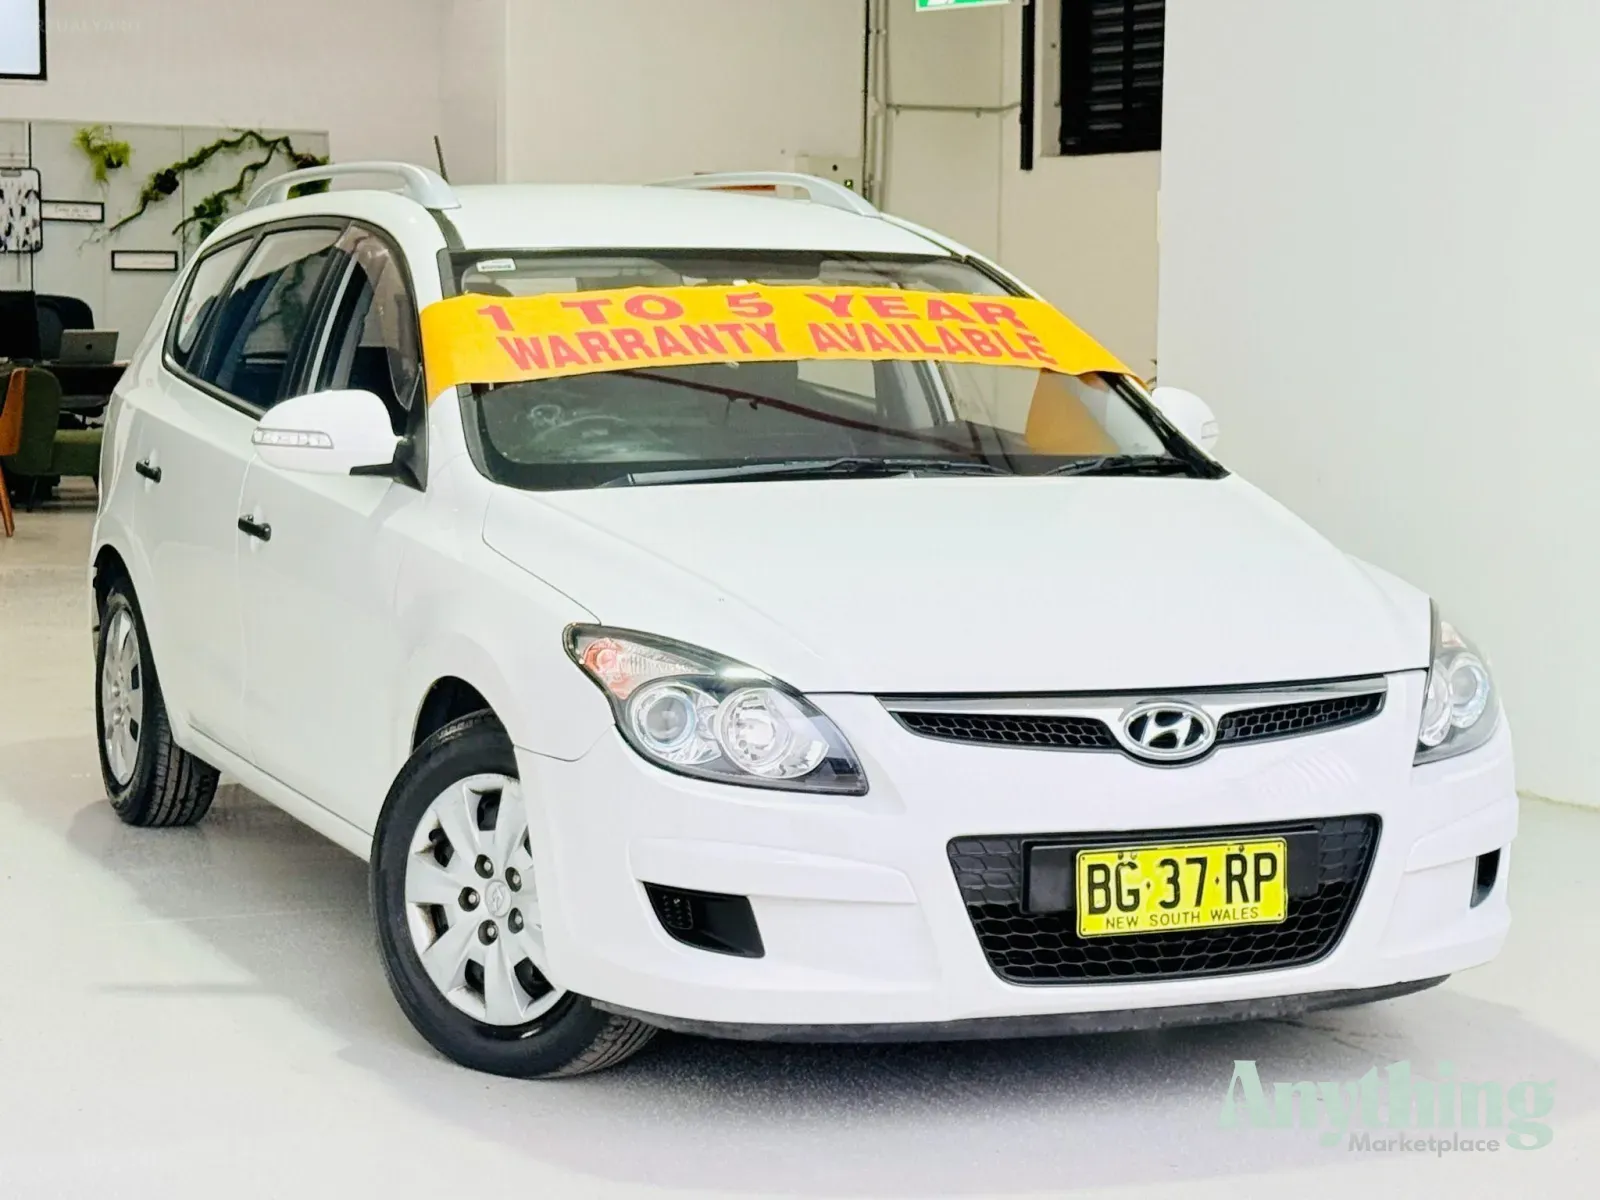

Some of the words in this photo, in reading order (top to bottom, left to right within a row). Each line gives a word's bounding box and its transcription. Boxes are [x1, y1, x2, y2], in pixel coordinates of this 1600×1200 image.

[476, 304, 515, 332] 1
[560, 294, 686, 326] TO
[725, 291, 774, 319] 5
[805, 294, 1030, 331] YEAR
[496, 322, 786, 371] WARRANTY
[808, 322, 1058, 365] AVAILABLE
[1105, 915, 1139, 930] NEW
[1149, 910, 1201, 927] SOUTH
[1210, 906, 1259, 921] WALES
